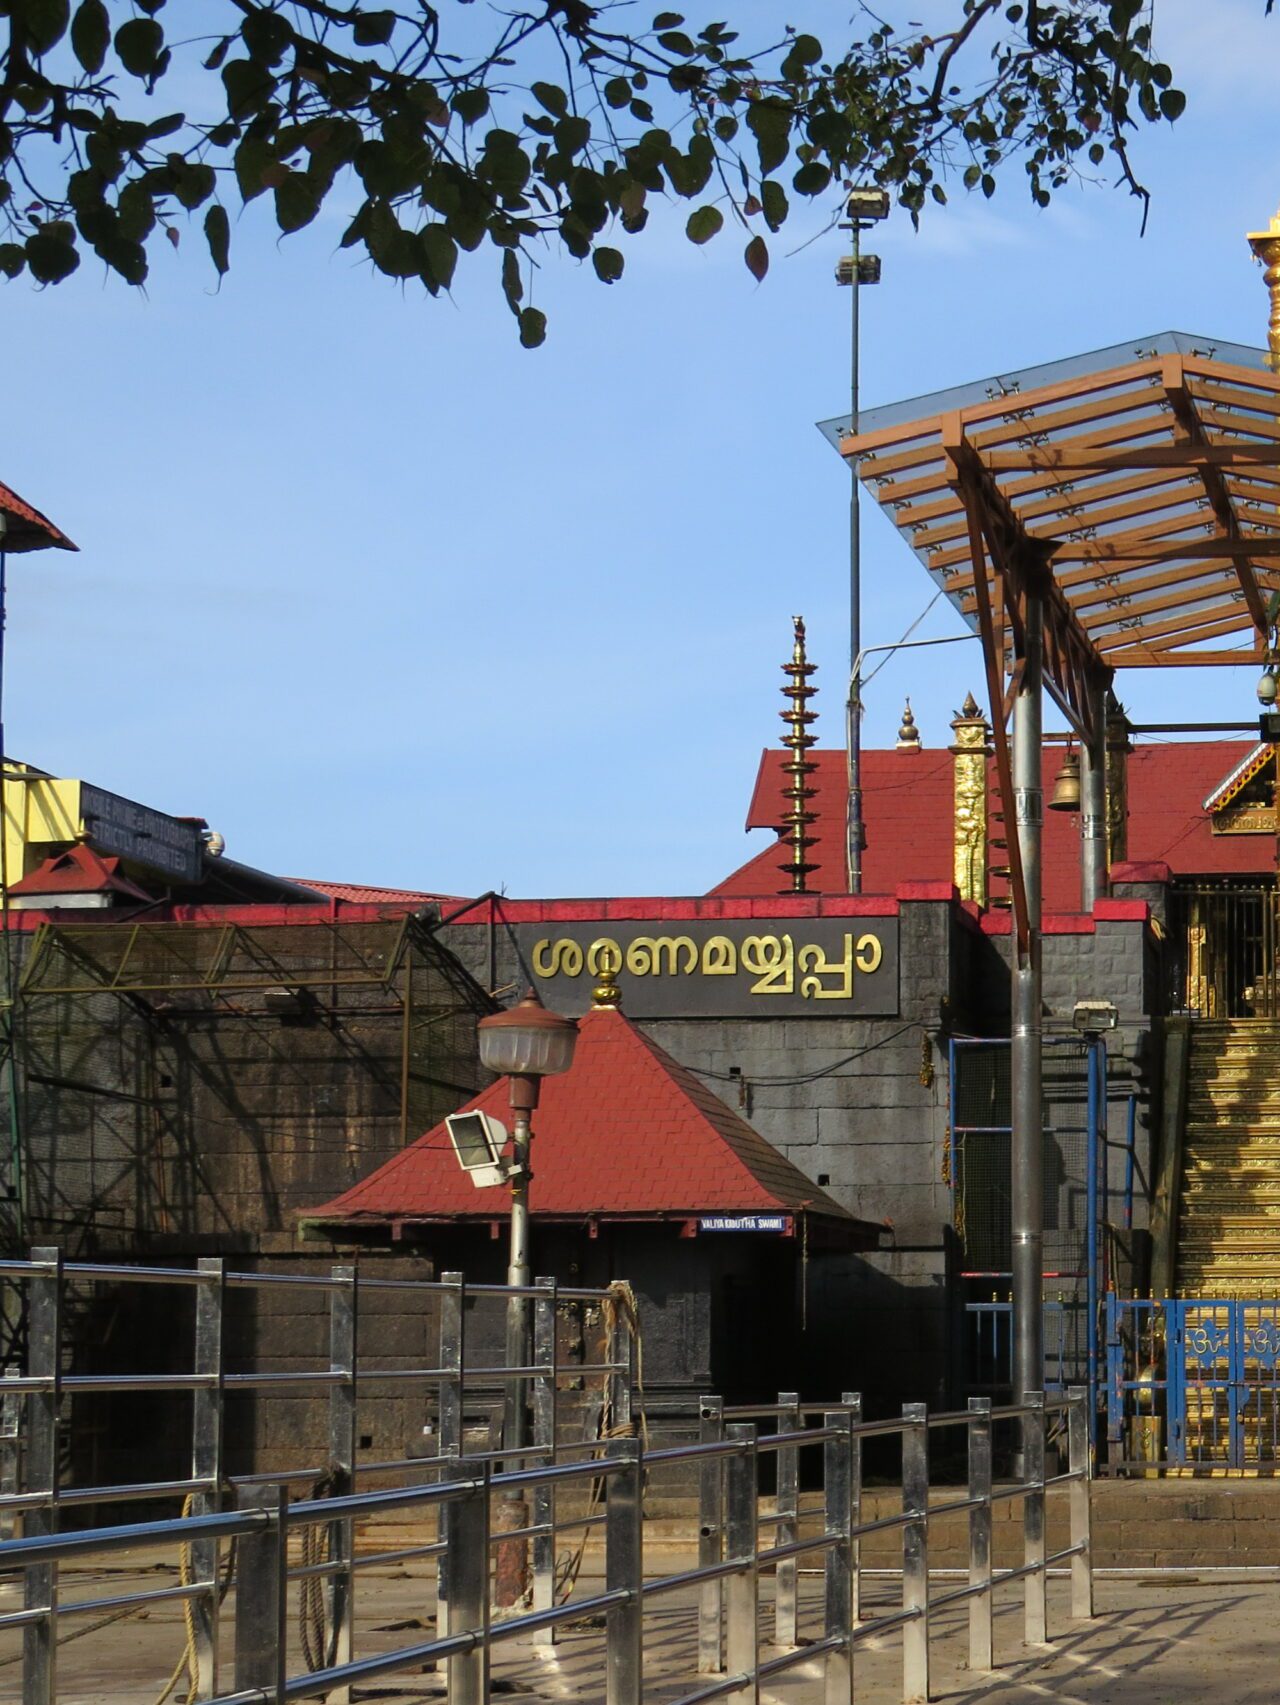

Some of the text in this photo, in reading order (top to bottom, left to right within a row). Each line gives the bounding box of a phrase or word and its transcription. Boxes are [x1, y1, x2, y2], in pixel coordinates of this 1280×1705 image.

[92, 820, 187, 872] STRICTLY PROHIBITED
[532, 932, 883, 1000] ശരണമയ്യപ്പാ
[701, 1218, 725, 1229] VALIYA
[758, 1218, 782, 1229] SWAMI
